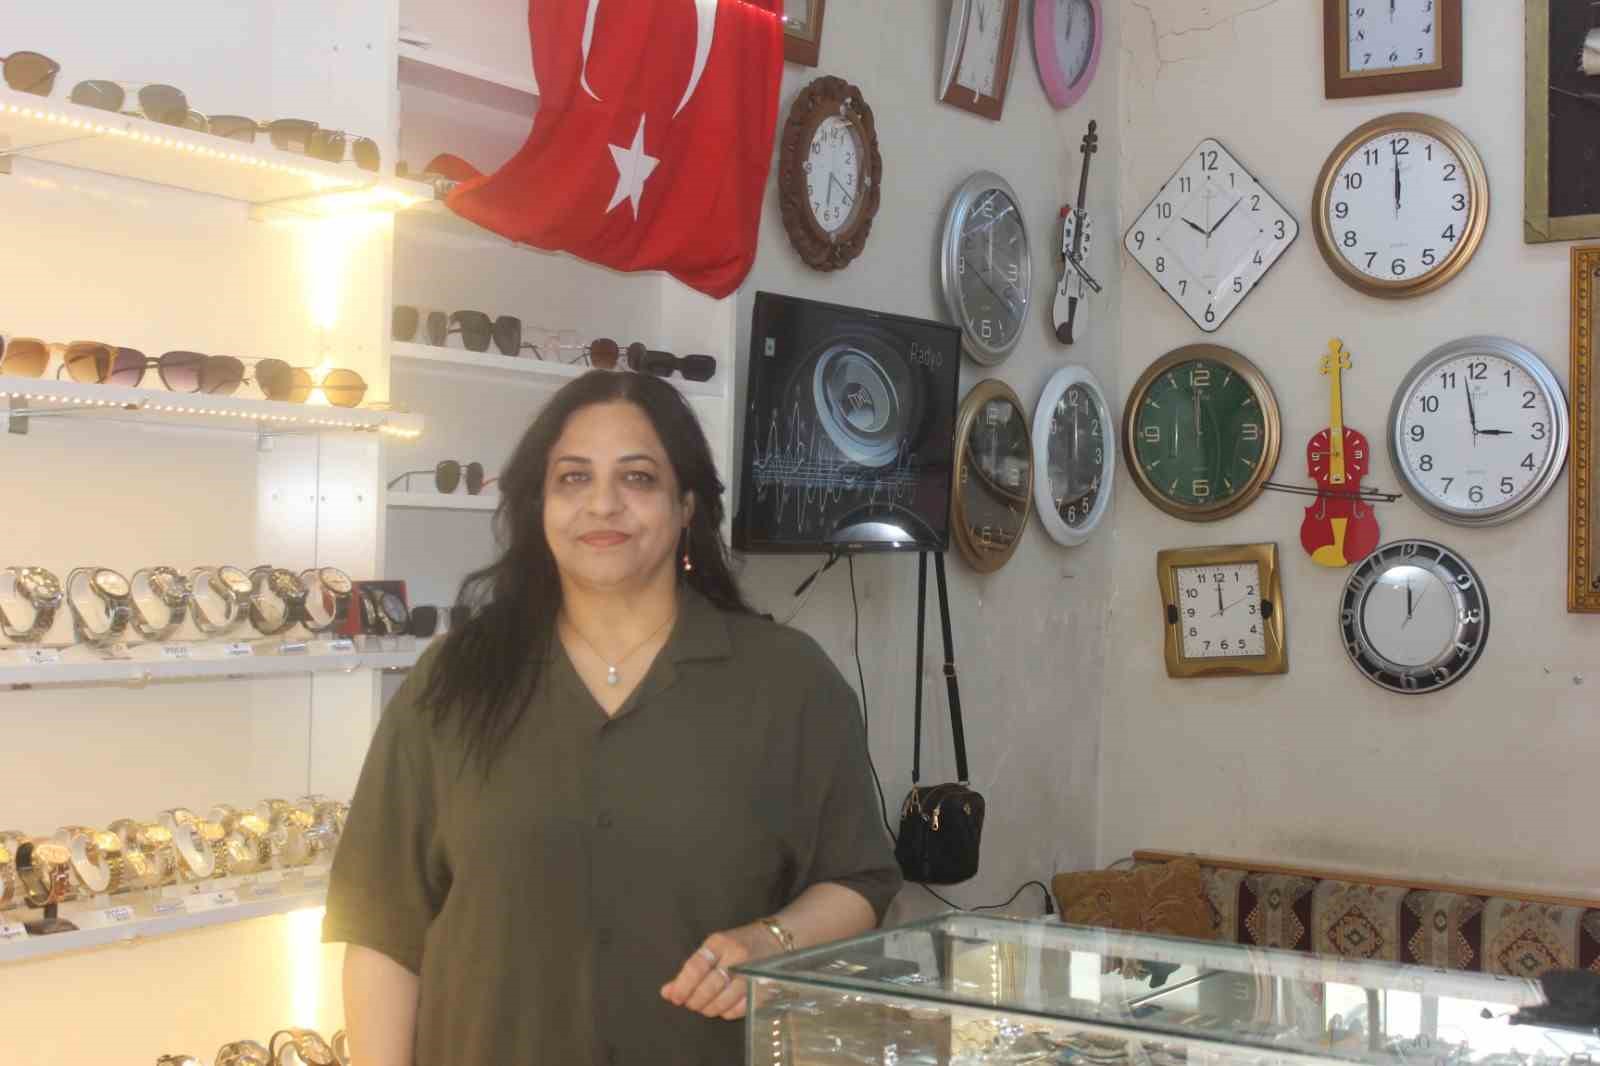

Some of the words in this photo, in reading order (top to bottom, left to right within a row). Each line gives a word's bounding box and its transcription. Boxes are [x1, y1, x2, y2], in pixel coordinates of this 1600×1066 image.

[1356, 8, 1365, 17] 9
[1356, 30, 1365, 40] 8
[1423, 24, 1431, 34] 4
[1364, 53, 1371, 64] 7
[1388, 51, 1398, 62] 6
[1414, 48, 1423, 60] 5
[1390, 138, 1409, 155] 12
[1425, 145, 1431, 160] 1
[1200, 151, 1217, 170] 12
[1365, 149, 1378, 165] 11
[1230, 173, 1234, 187] 1
[1443, 164, 1456, 181] 2
[1179, 177, 1190, 192] 11
[1345, 173, 1362, 189] 10
[1156, 203, 1171, 218] 10
[1251, 195, 1260, 211] 2
[1336, 202, 1348, 218] 9
[1451, 194, 1465, 211] 3
[1274, 220, 1284, 240] 3
[1441, 224, 1455, 242] 4
[1135, 231, 1144, 249] 9
[1344, 231, 1357, 247] 8
[1156, 257, 1164, 272] 8
[1253, 251, 1261, 265] 4
[1365, 252, 1377, 268] 7
[1422, 249, 1435, 265] 5
[1392, 259, 1406, 275] 6
[1179, 280, 1187, 296] 7
[1234, 277, 1242, 293] 5
[1205, 304, 1215, 322] 6
[982, 320, 991, 337] 6
[1190, 370, 1210, 386] 12
[1468, 363, 1487, 379] 12
[1504, 370, 1510, 387] 1
[1441, 373, 1455, 389] 11
[1069, 390, 1078, 406] 12
[1420, 396, 1438, 412] 10
[1522, 392, 1535, 408] 2
[1092, 419, 1098, 435] 2
[1145, 426, 1159, 442] 9
[1242, 424, 1257, 440] 3
[1411, 425, 1424, 441] 9
[1531, 423, 1545, 439] 3
[1096, 448, 1101, 464] 3
[1420, 455, 1432, 471] 8
[1521, 454, 1535, 470] 4
[1193, 480, 1209, 496] 6
[1441, 478, 1454, 494] 7
[1501, 477, 1513, 493] 5
[1469, 486, 1483, 502] 6
[1082, 497, 1088, 513] 5
[1068, 506, 1075, 522] 6
[1197, 574, 1205, 583] 11
[1213, 573, 1224, 582] 12
[1235, 572, 1239, 582] 1
[1186, 589, 1198, 598] 10
[1247, 586, 1254, 595] 2
[1187, 608, 1195, 617] 9
[1249, 605, 1256, 614] 3
[1190, 628, 1197, 636] 8
[1250, 625, 1257, 633] 4
[1202, 641, 1210, 650] 7
[1221, 640, 1228, 649] 6
[1238, 640, 1246, 648] 5
